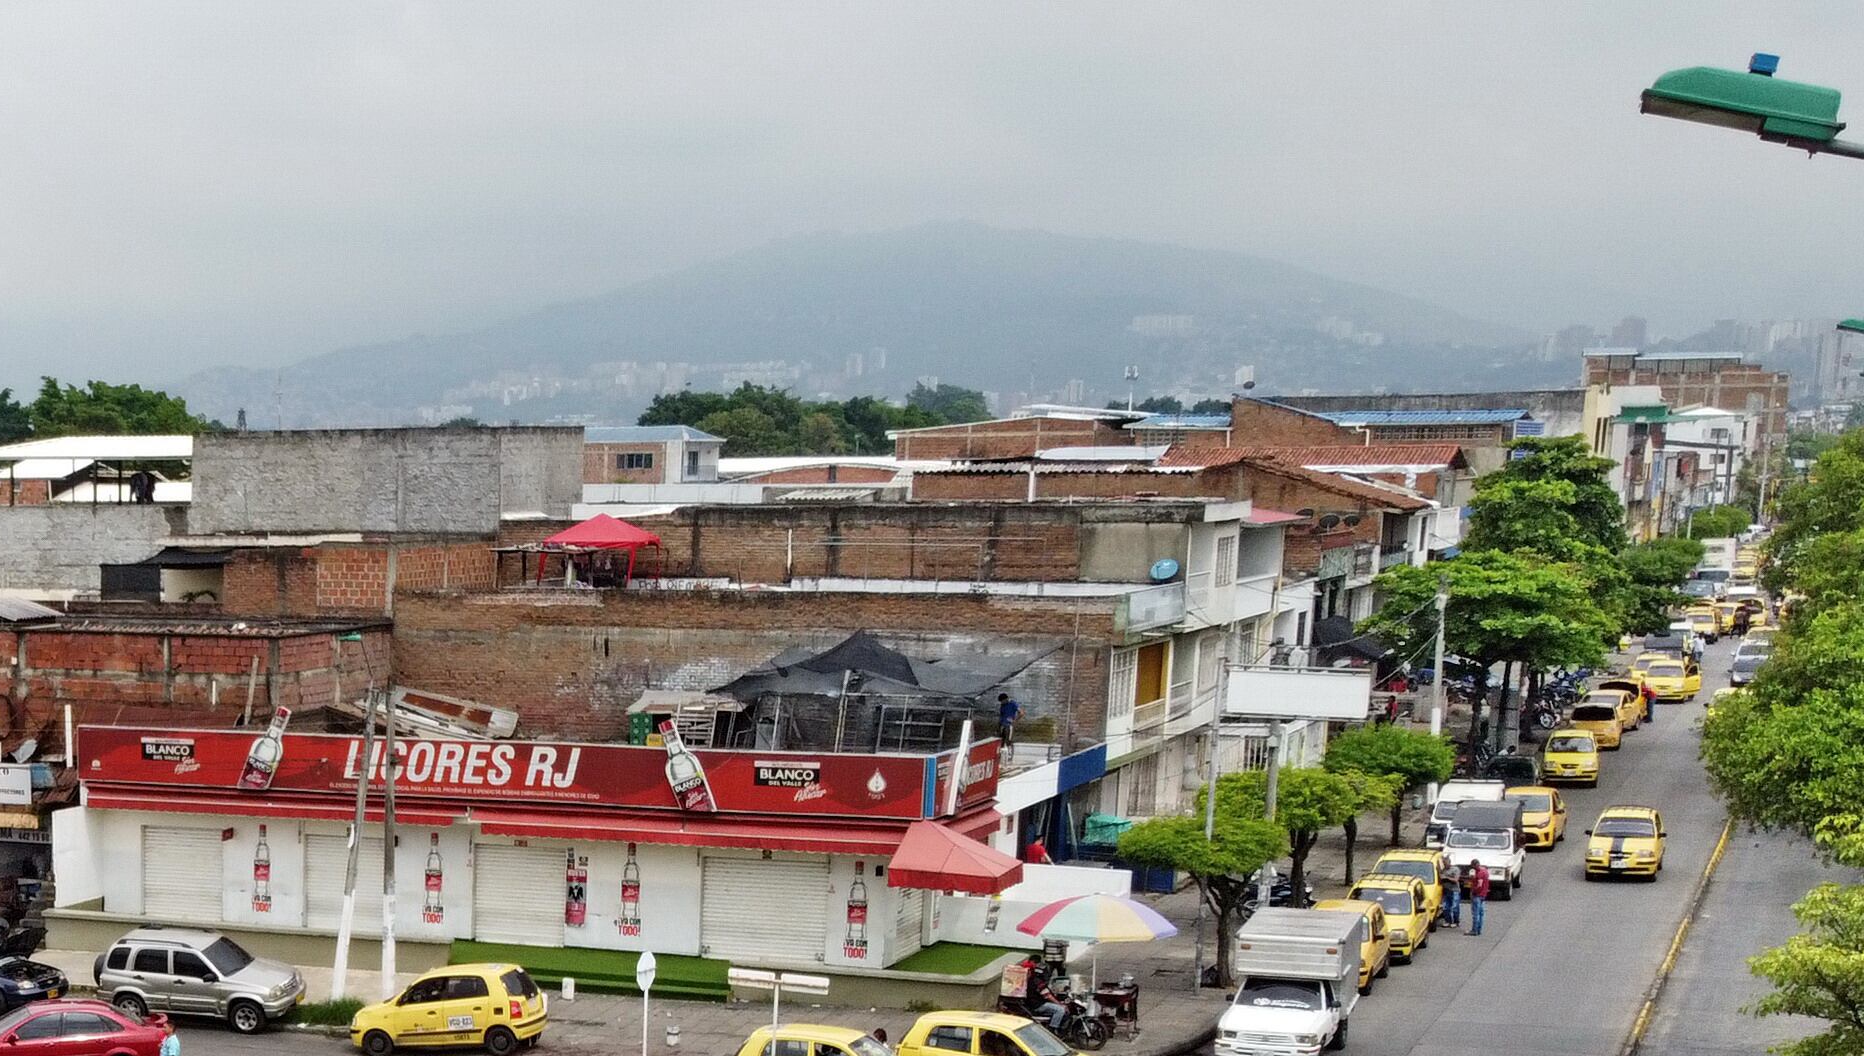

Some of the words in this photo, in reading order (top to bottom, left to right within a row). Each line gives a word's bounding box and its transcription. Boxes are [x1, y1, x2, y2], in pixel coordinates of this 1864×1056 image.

[145, 744, 190, 756] BLANCO
[343, 740, 515, 786] LICORES
[525, 746, 581, 788] RJ
[759, 769, 815, 780] BLANCO
